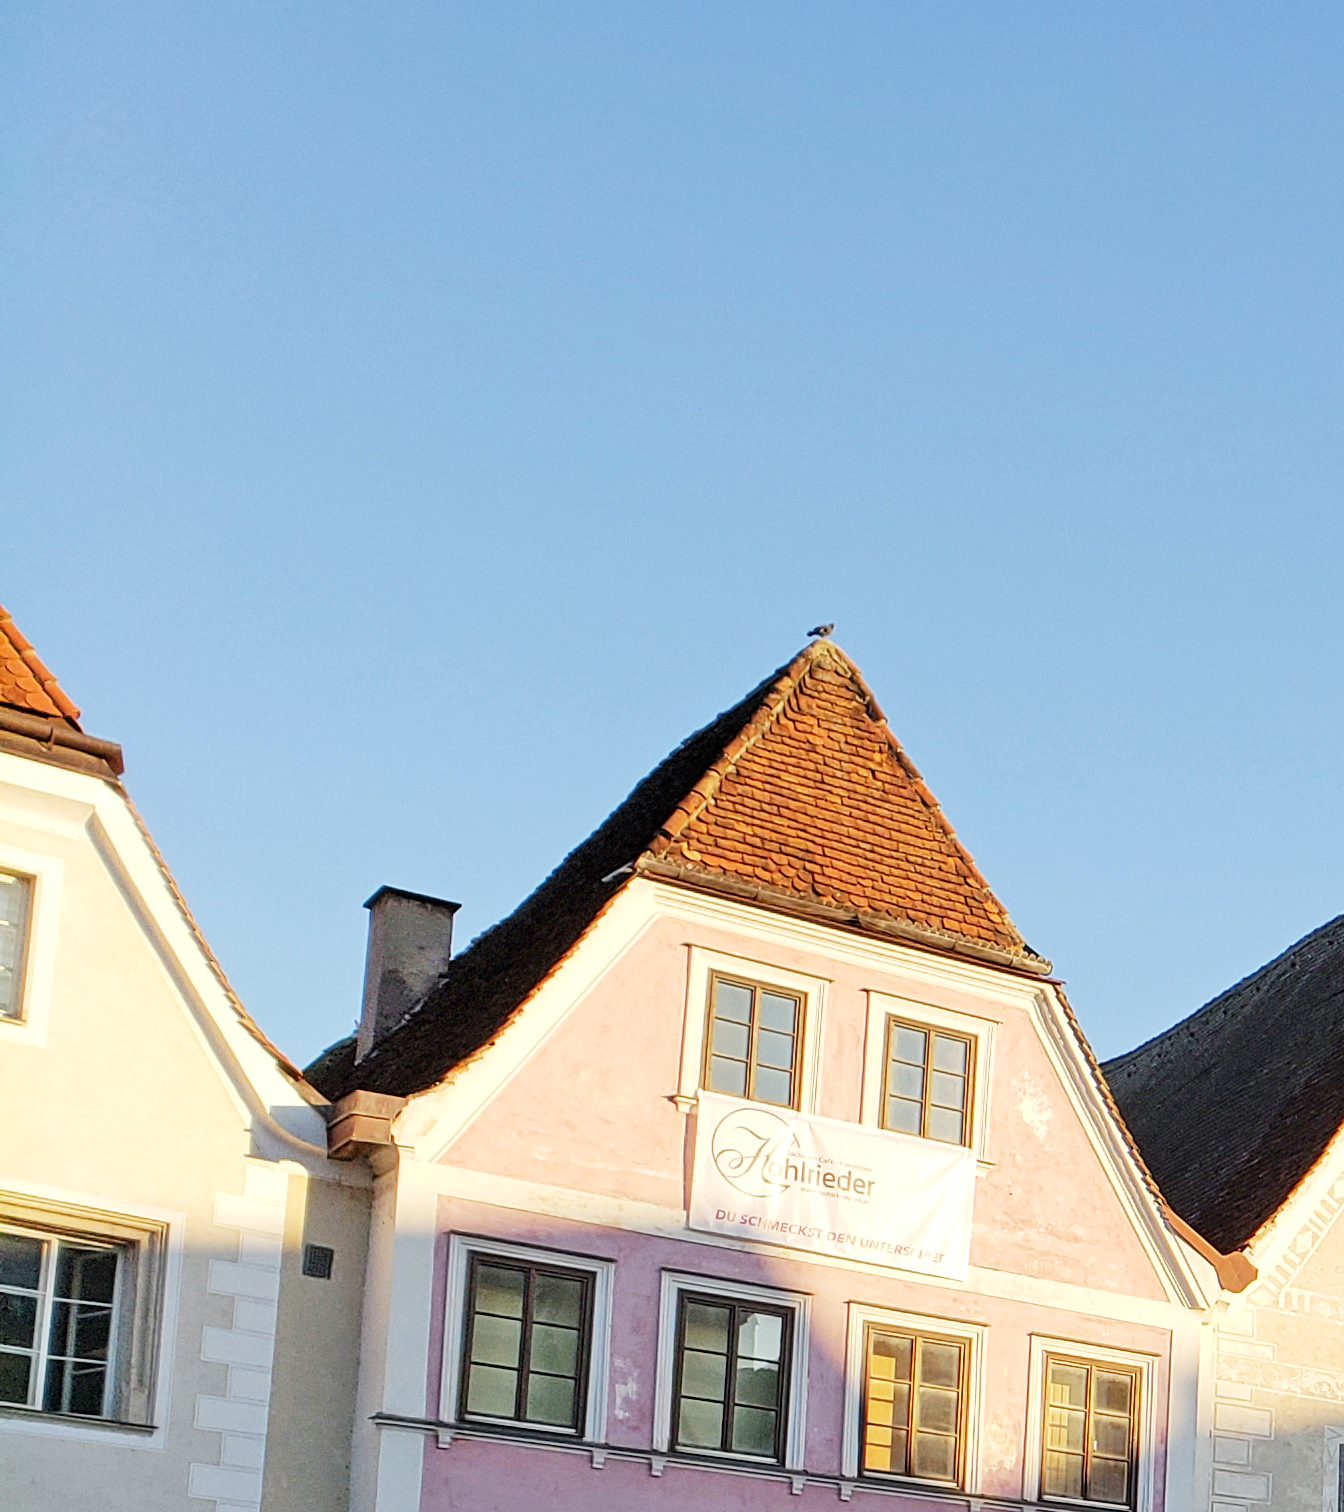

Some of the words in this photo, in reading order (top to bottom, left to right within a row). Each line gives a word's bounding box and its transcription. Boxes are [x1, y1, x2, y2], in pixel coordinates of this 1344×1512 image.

[715, 1208, 736, 1222] DU
[739, 1213, 823, 1240] SCHMECKST
[827, 1230, 857, 1247] DEN
